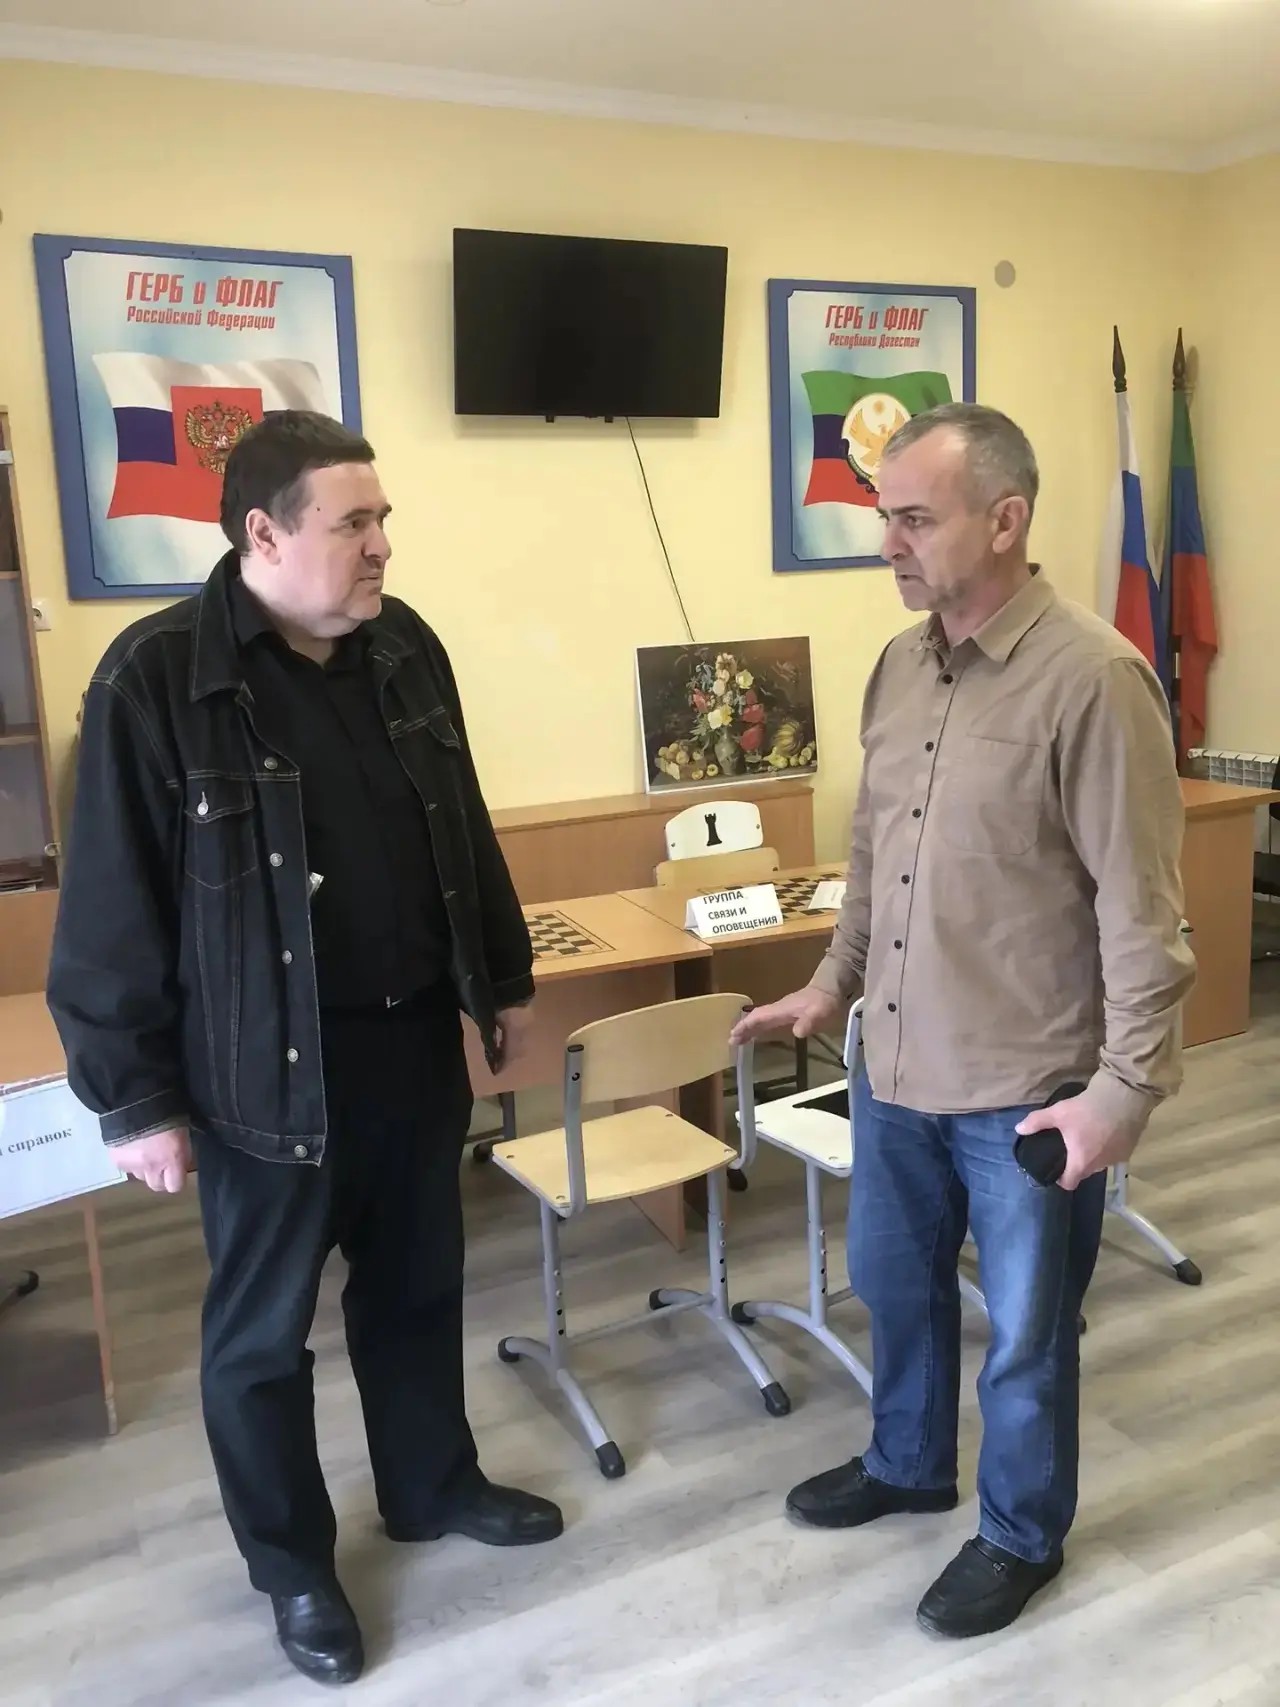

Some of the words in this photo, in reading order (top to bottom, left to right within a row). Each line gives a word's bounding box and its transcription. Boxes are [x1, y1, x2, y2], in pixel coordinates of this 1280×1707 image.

[126, 271, 185, 304] ГЕРБ
[216, 275, 285, 308] ФЛАГ
[127, 305, 202, 326] Российской
[207, 309, 276, 331] Федерации
[825, 305, 865, 329] ГЕРБ
[868, 311, 879, 330] и
[883, 305, 929, 331] ФЛАГ
[828, 332, 877, 350] Республики
[878, 334, 921, 349] Дагестан
[703, 890, 744, 905] ГРУППА
[708, 908, 738, 920] СВЯЗИ
[739, 906, 747, 915] И
[712, 915, 778, 934] ОПОВЕЩЕНИЯ
[7, 1128, 72, 1154] справок
